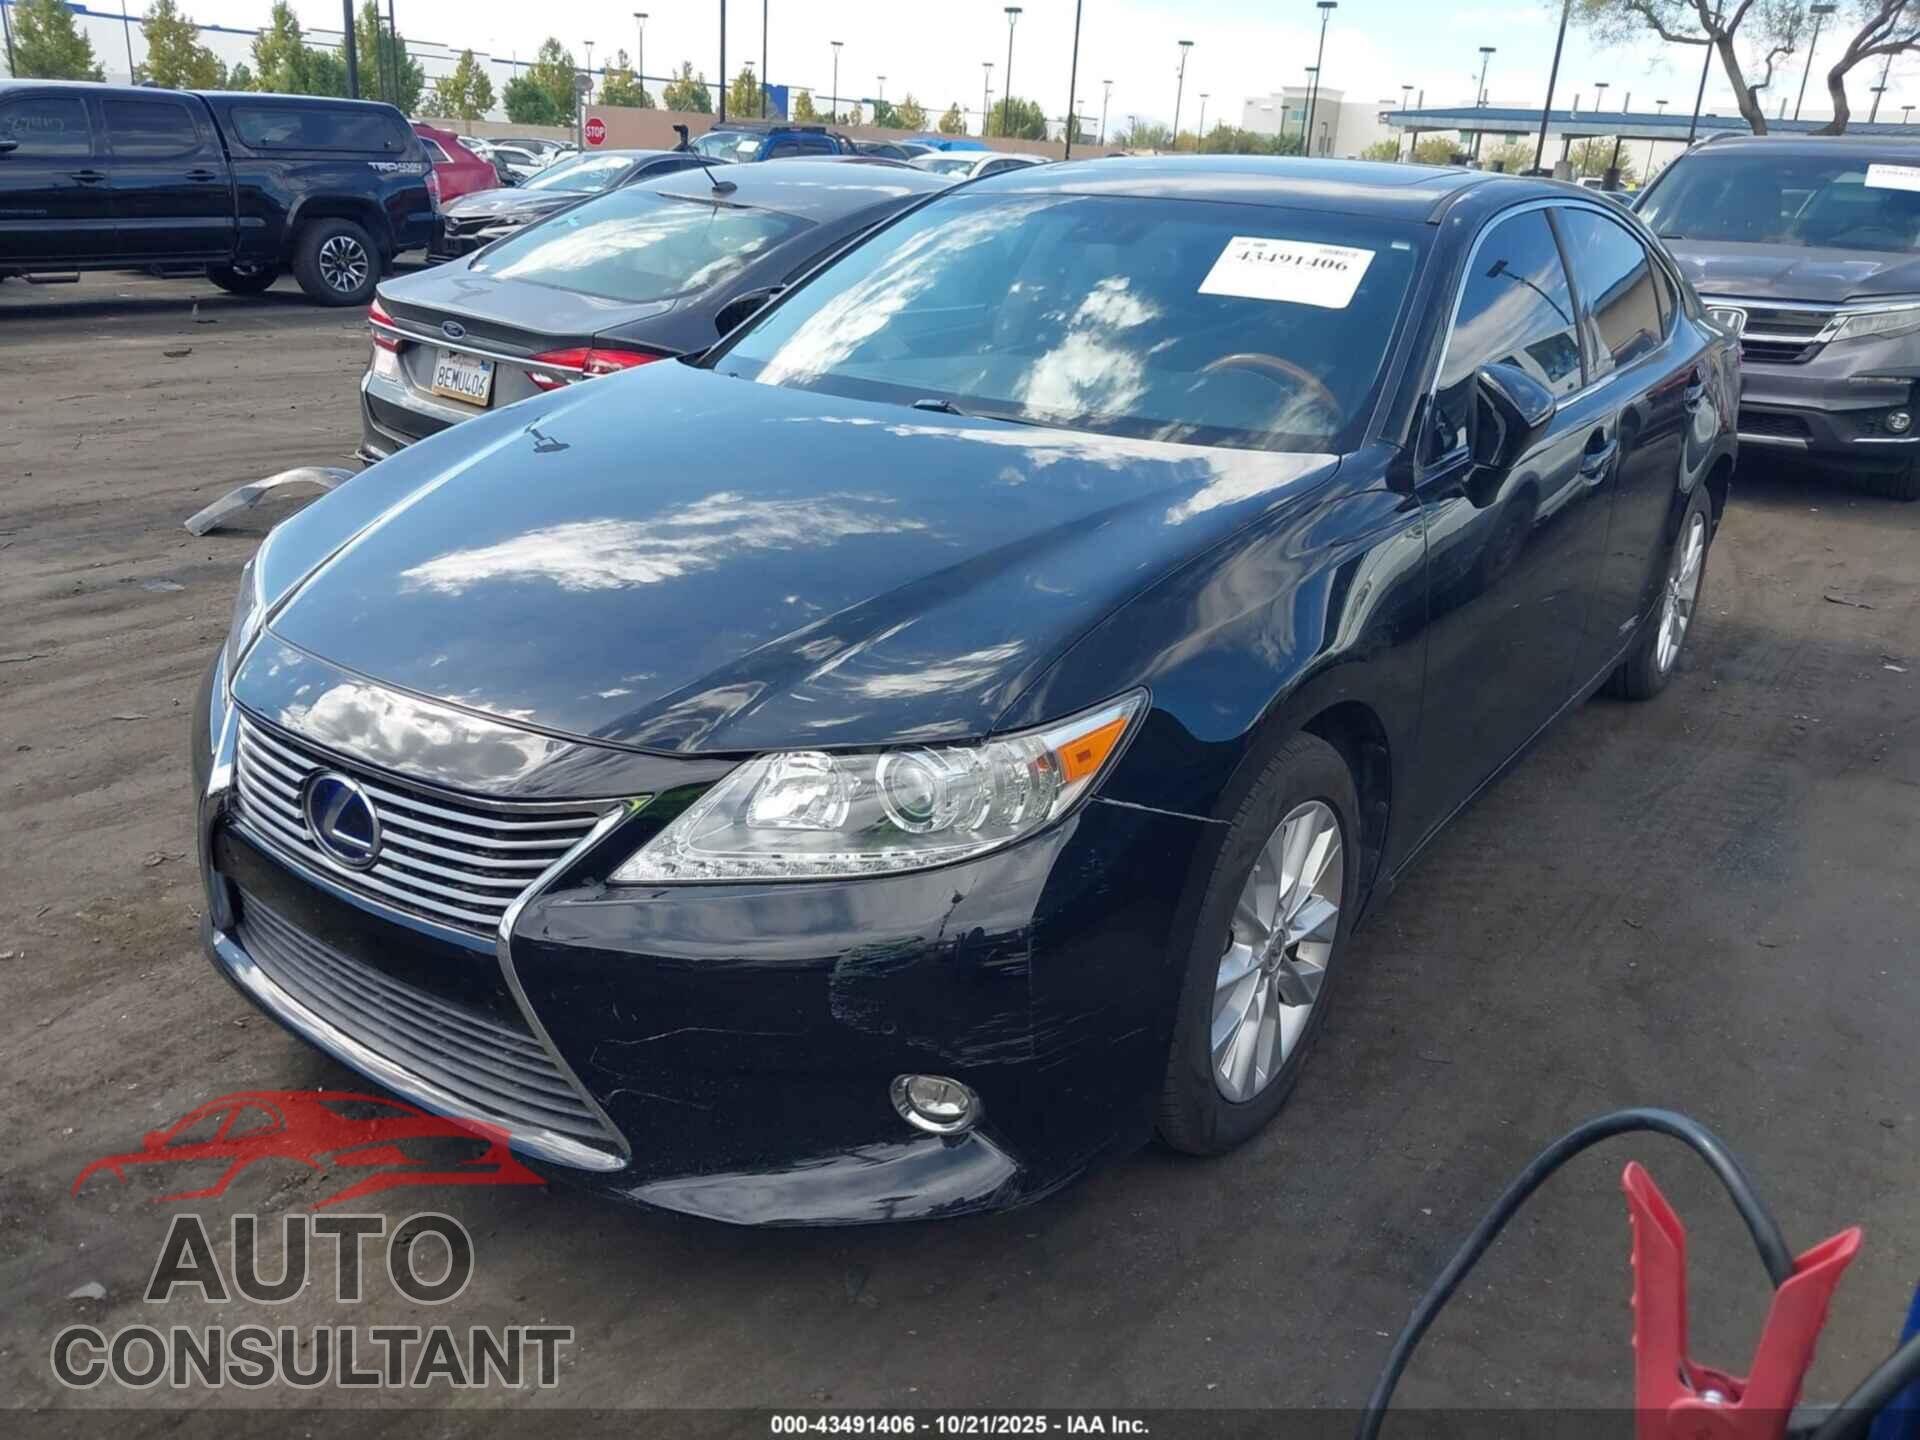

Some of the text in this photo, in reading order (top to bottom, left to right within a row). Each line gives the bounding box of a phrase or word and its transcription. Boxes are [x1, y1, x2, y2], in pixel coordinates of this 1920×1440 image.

[585, 126, 605, 137] STOP
[1236, 251, 1348, 271] 43491406
[437, 366, 487, 397] 8EMU406
